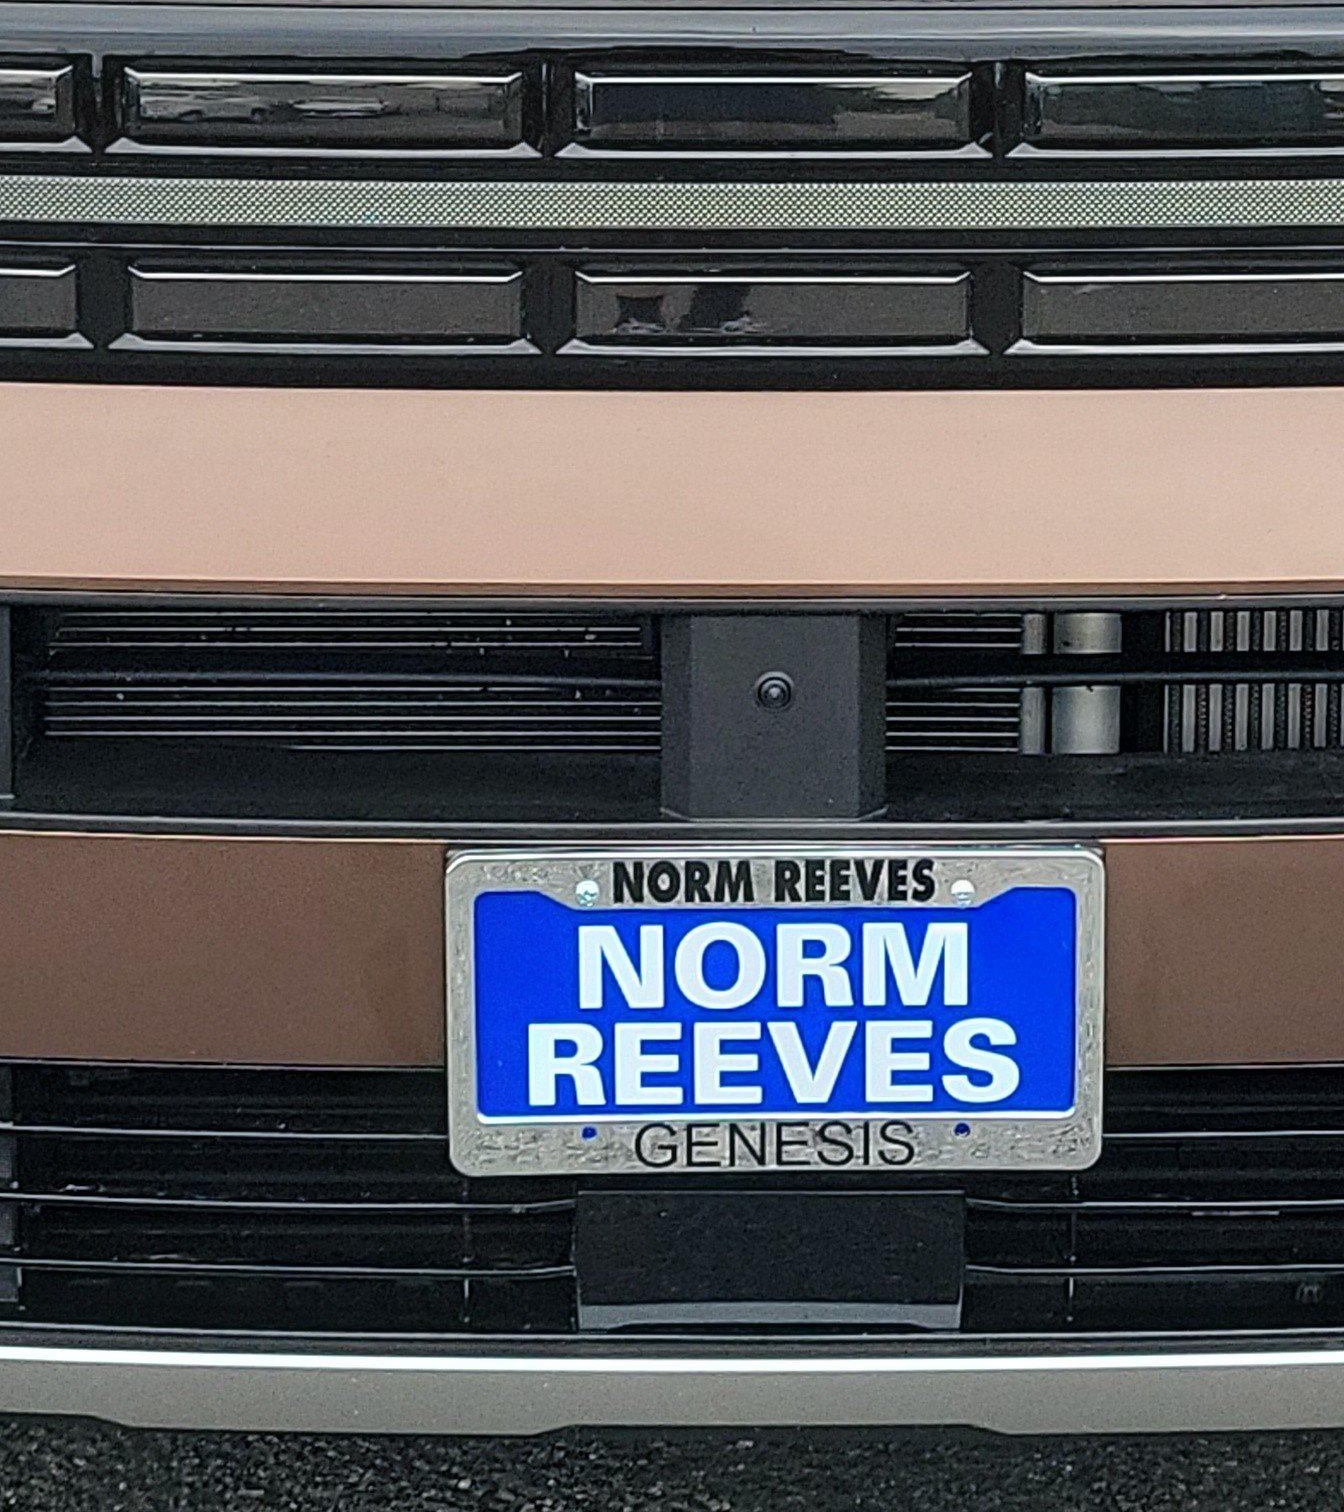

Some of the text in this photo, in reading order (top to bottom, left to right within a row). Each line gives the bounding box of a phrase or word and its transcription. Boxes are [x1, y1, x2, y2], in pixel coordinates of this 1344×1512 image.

[612, 858, 936, 904] NORM REEVES
[576, 921, 969, 1010] NORM
[526, 1017, 1022, 1106] REEVES
[633, 1121, 917, 1167] GENESIS
